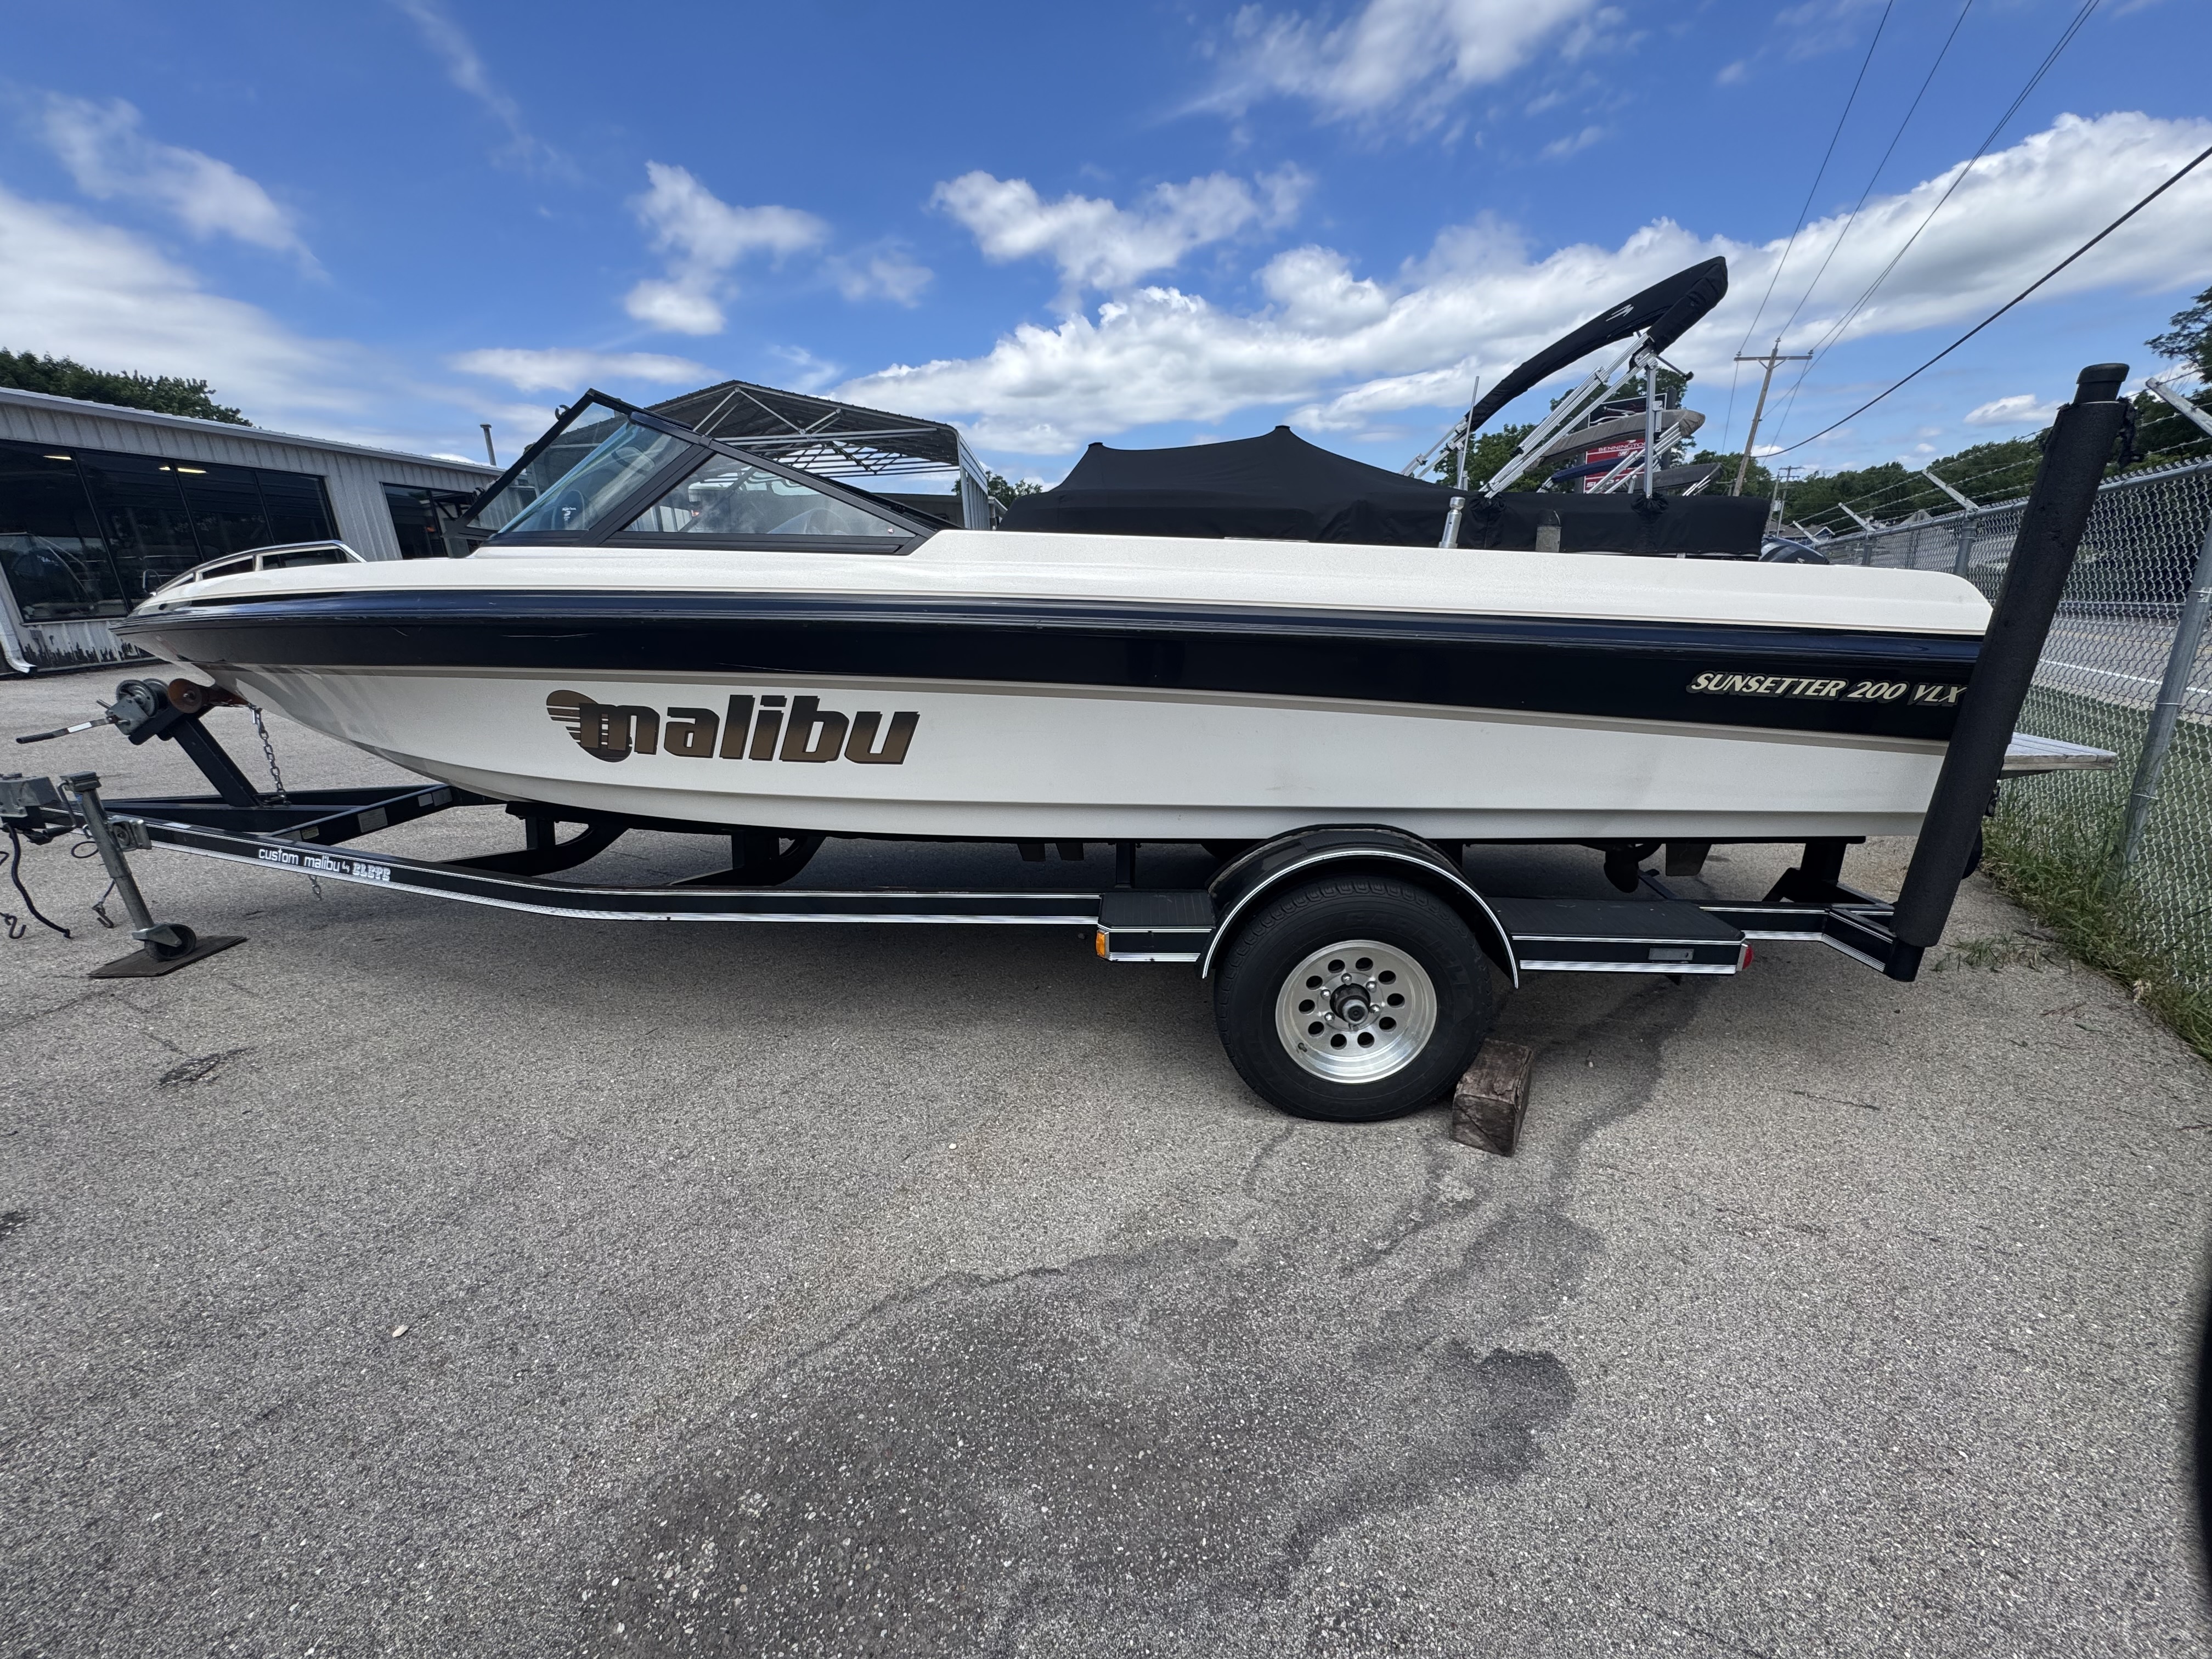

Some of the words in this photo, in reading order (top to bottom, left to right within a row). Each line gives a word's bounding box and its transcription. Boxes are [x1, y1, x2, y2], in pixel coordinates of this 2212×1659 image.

[1599, 442, 1645, 452] BENNINGTO
[1690, 673, 1847, 698] SUNSETTER
[1847, 681, 1908, 700] 200
[1912, 684, 1967, 704] VLX
[579, 695, 921, 765] malibu
[258, 848, 298, 865] custom
[304, 855, 340, 872] malibu
[342, 862, 349, 873] by
